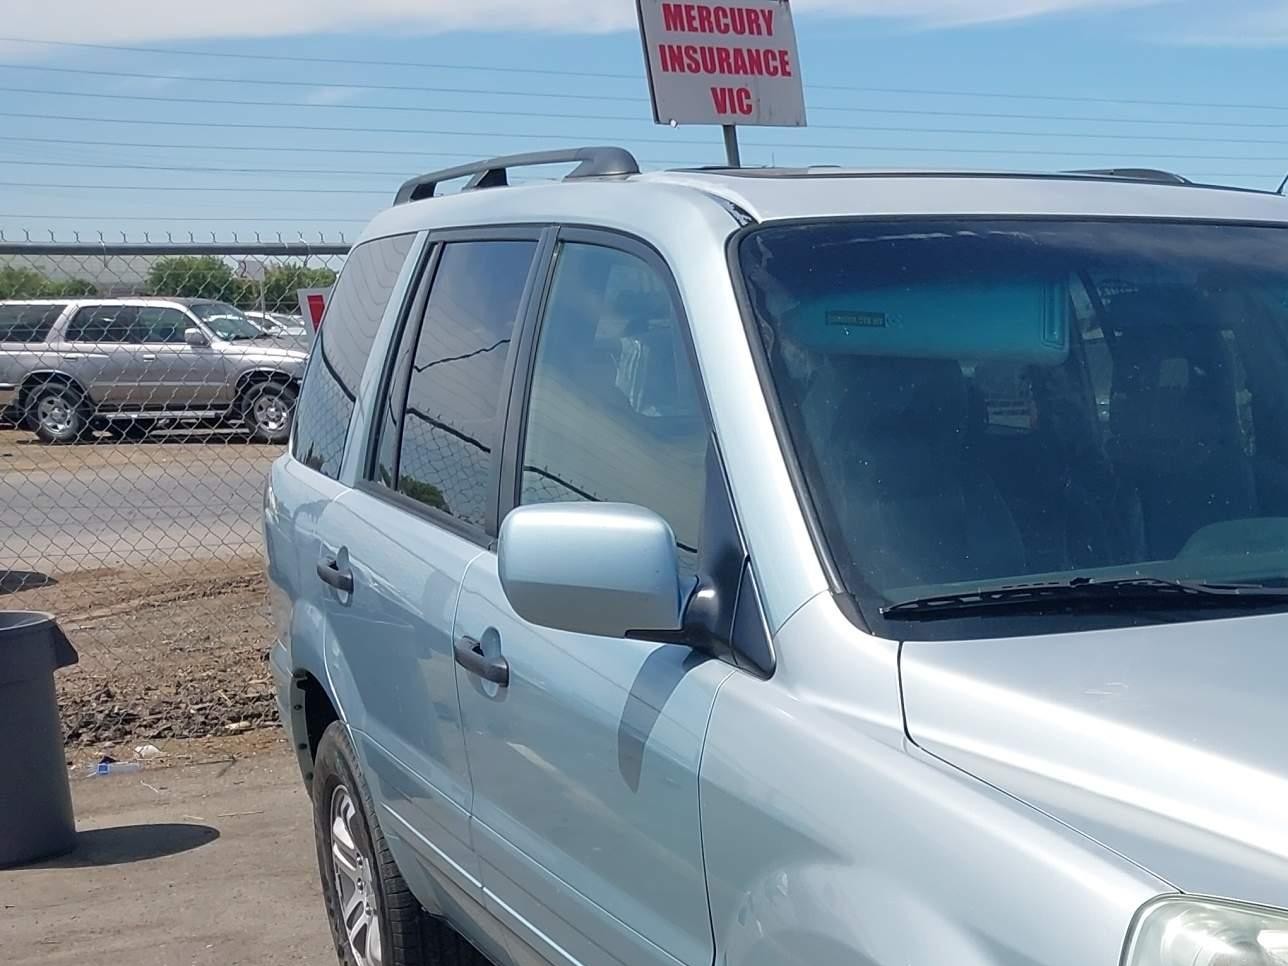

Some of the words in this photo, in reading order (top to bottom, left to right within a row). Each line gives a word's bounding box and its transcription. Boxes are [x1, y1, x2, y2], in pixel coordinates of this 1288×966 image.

[662, 3, 774, 36] MERCURY
[658, 44, 792, 77] INSURANCE
[711, 87, 753, 115] VIC
